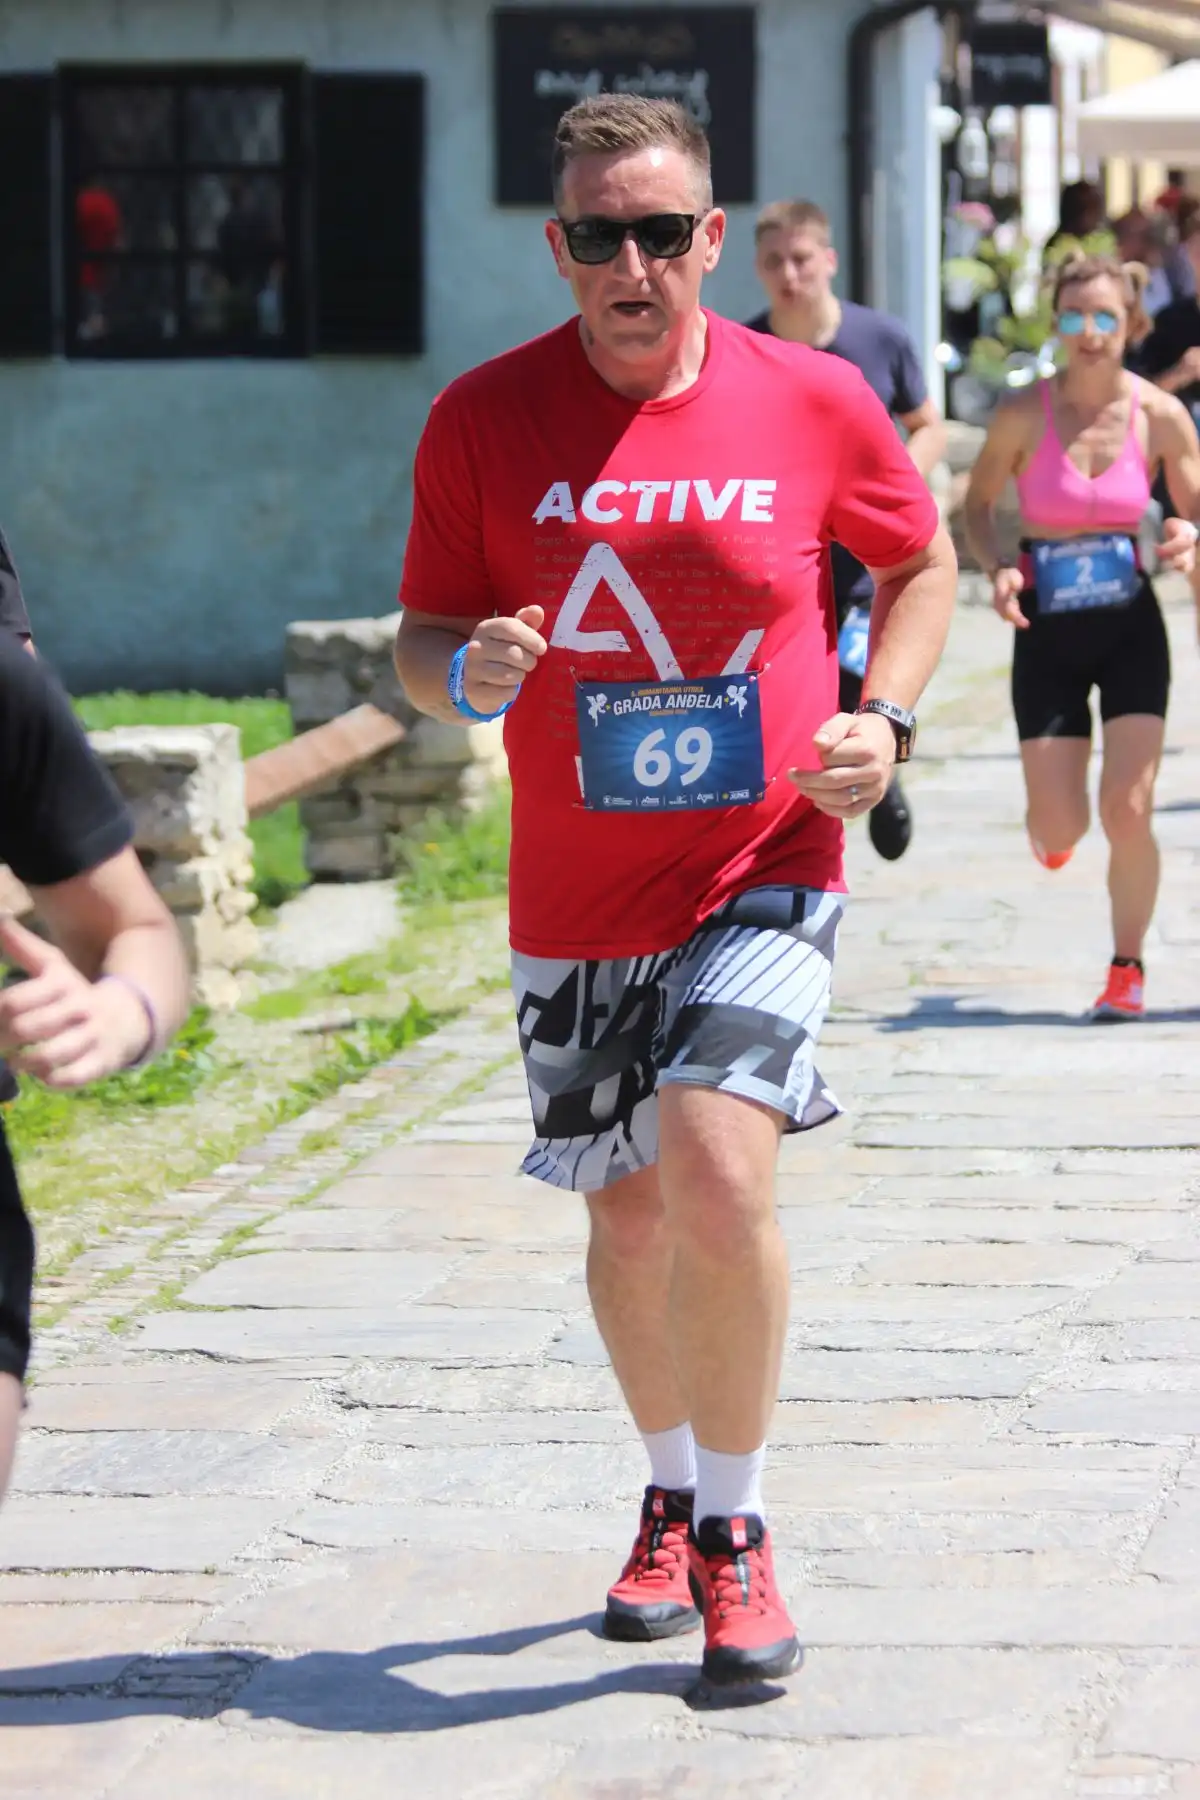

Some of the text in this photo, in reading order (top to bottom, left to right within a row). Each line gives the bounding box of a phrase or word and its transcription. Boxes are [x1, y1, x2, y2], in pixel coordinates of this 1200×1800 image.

[532, 479, 777, 525] ACTIVE
[1075, 556, 1094, 585] 2
[613, 693, 723, 716] GRADA ANĐELA
[633, 726, 713, 787] 69
